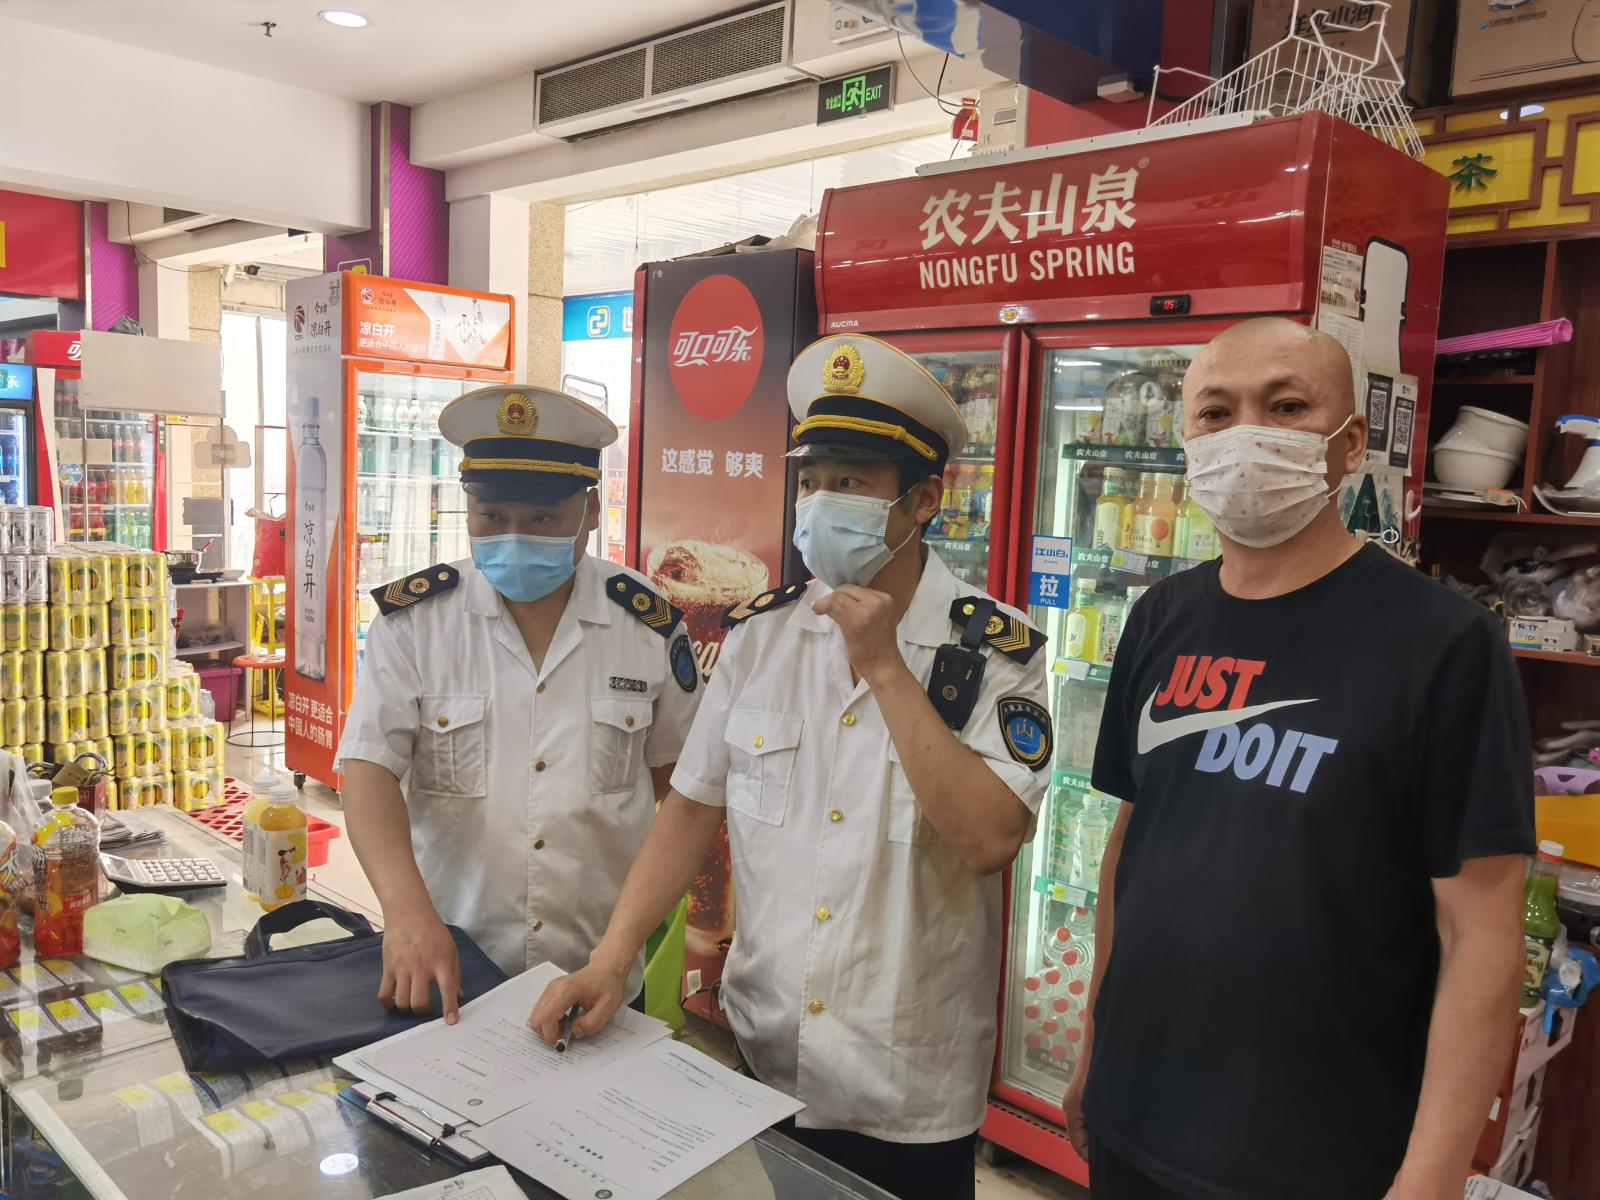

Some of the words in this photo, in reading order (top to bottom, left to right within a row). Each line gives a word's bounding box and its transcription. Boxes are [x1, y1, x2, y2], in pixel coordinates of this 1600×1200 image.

[866, 84, 883, 101] EXIT
[1449, 153, 1498, 195] 茶
[919, 164, 1140, 250] 农夫山泉
[919, 253, 1018, 290] NONGFU
[1029, 241, 1136, 282] SPRING
[310, 320, 332, 338] 凉白开
[359, 321, 395, 338] 凉白开
[830, 319, 859, 328] AUCMA
[673, 326, 759, 367] 可口可乐
[661, 447, 714, 475] 这感觉
[725, 451, 764, 479] 够爽
[1076, 448, 1108, 458] 农夫山泉
[1125, 450, 1158, 460] 农夫山泉
[303, 519, 316, 600] 凉白开
[1035, 547, 1066, 558] 江小白
[1040, 574, 1059, 598] 拉
[1040, 597, 1057, 606] PULL
[1155, 655, 1266, 711] JUST
[288, 691, 310, 716] 凉白开
[311, 699, 333, 726] 更适合
[288, 713, 333, 750] 中国人的肠胃
